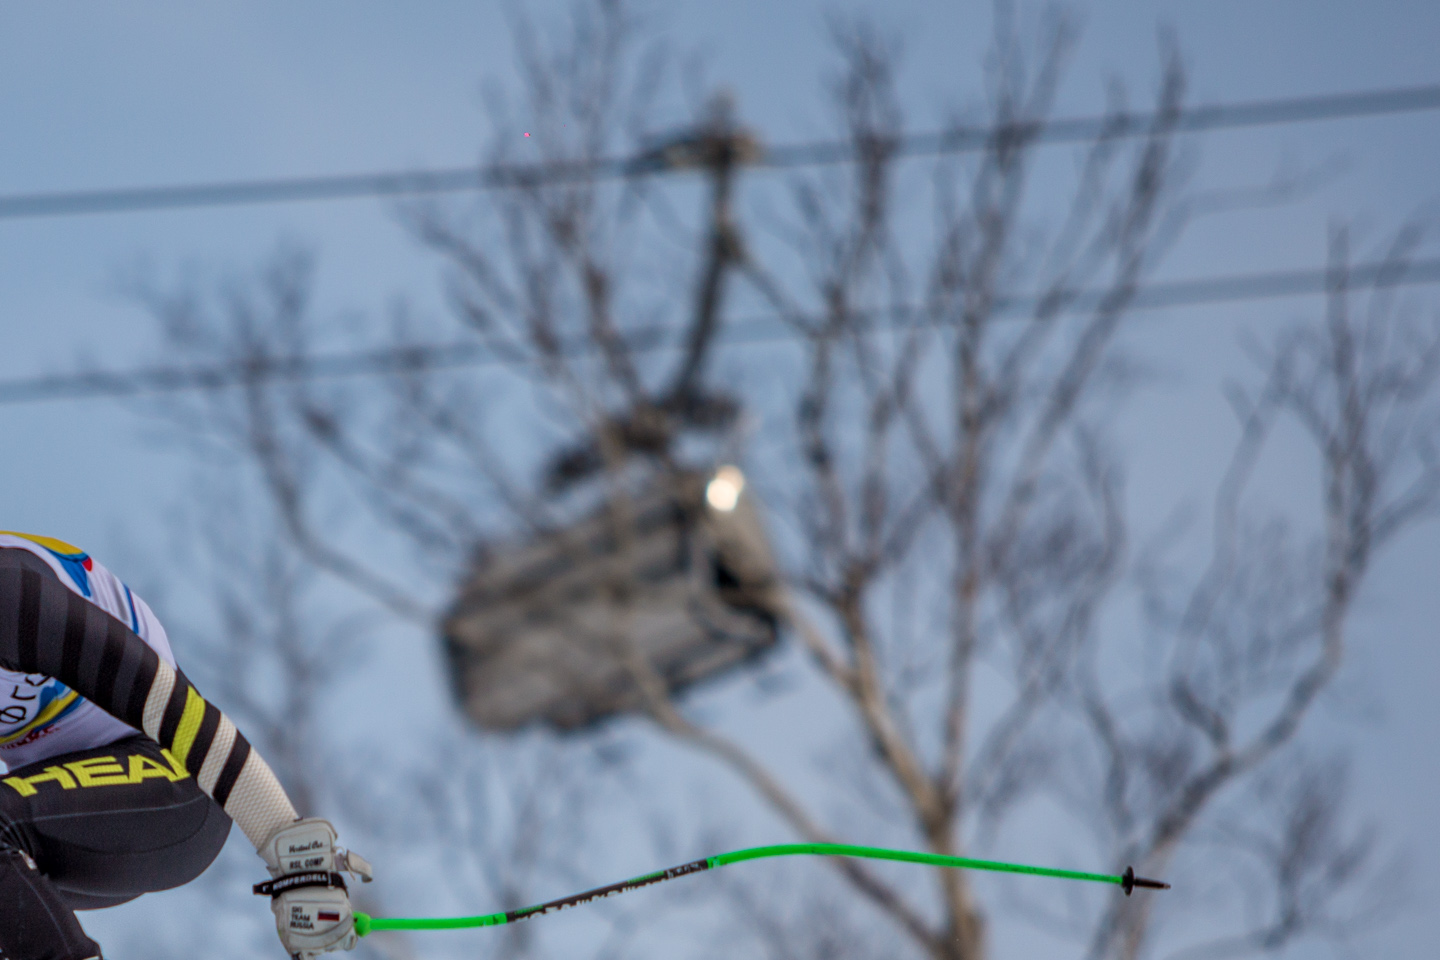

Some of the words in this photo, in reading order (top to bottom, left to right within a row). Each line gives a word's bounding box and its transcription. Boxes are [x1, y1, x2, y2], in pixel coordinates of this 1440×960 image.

[305, 857, 324, 868] COMP
[291, 913, 310, 921] TEAM
[290, 921, 314, 929] RUSSIA
